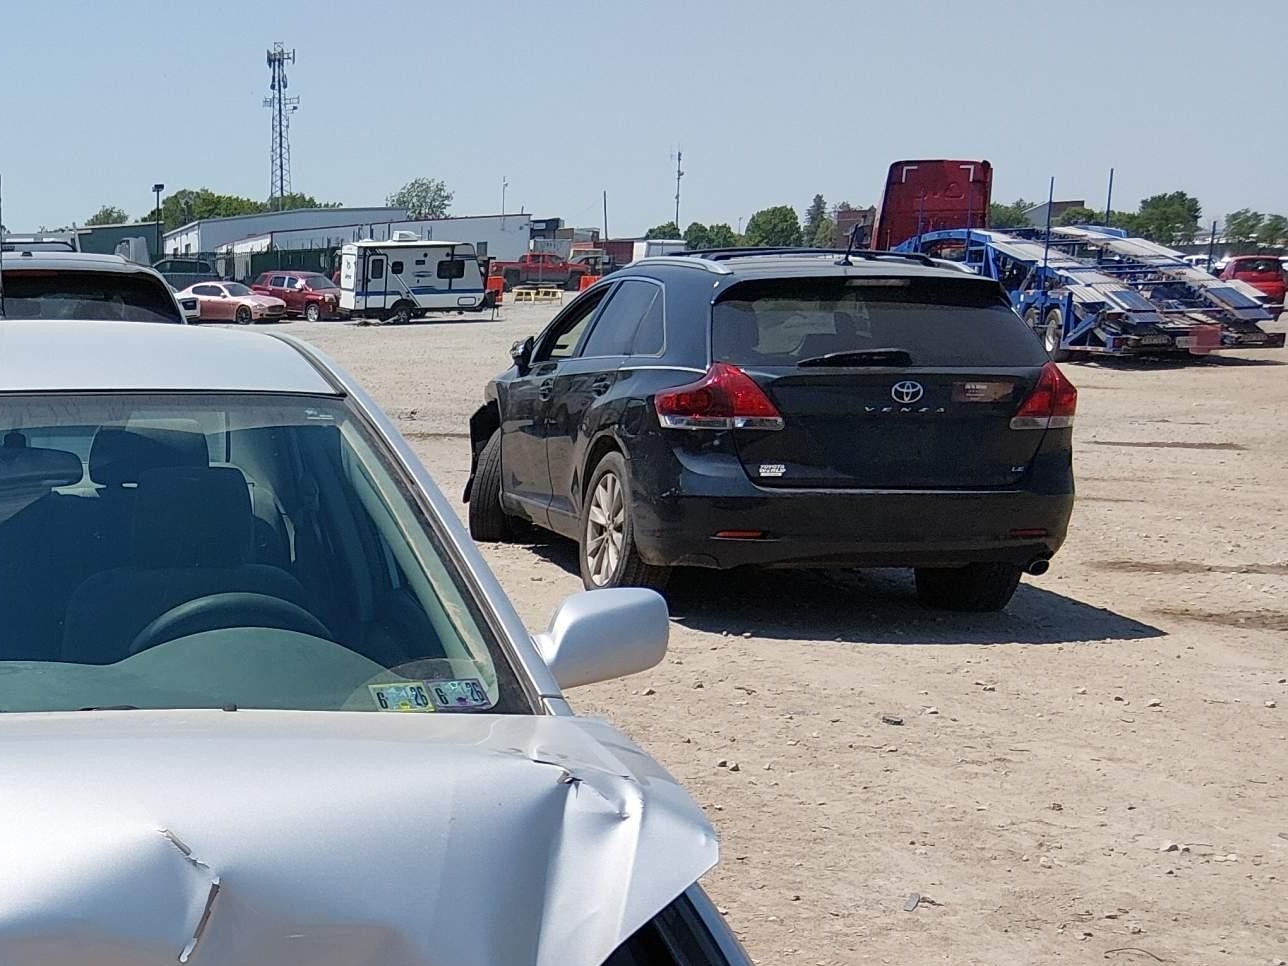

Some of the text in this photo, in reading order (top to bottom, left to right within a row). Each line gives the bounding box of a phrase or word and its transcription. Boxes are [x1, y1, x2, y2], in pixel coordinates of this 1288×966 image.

[376, 686, 429, 709] 6 26
[435, 682, 485, 705] 6 26
